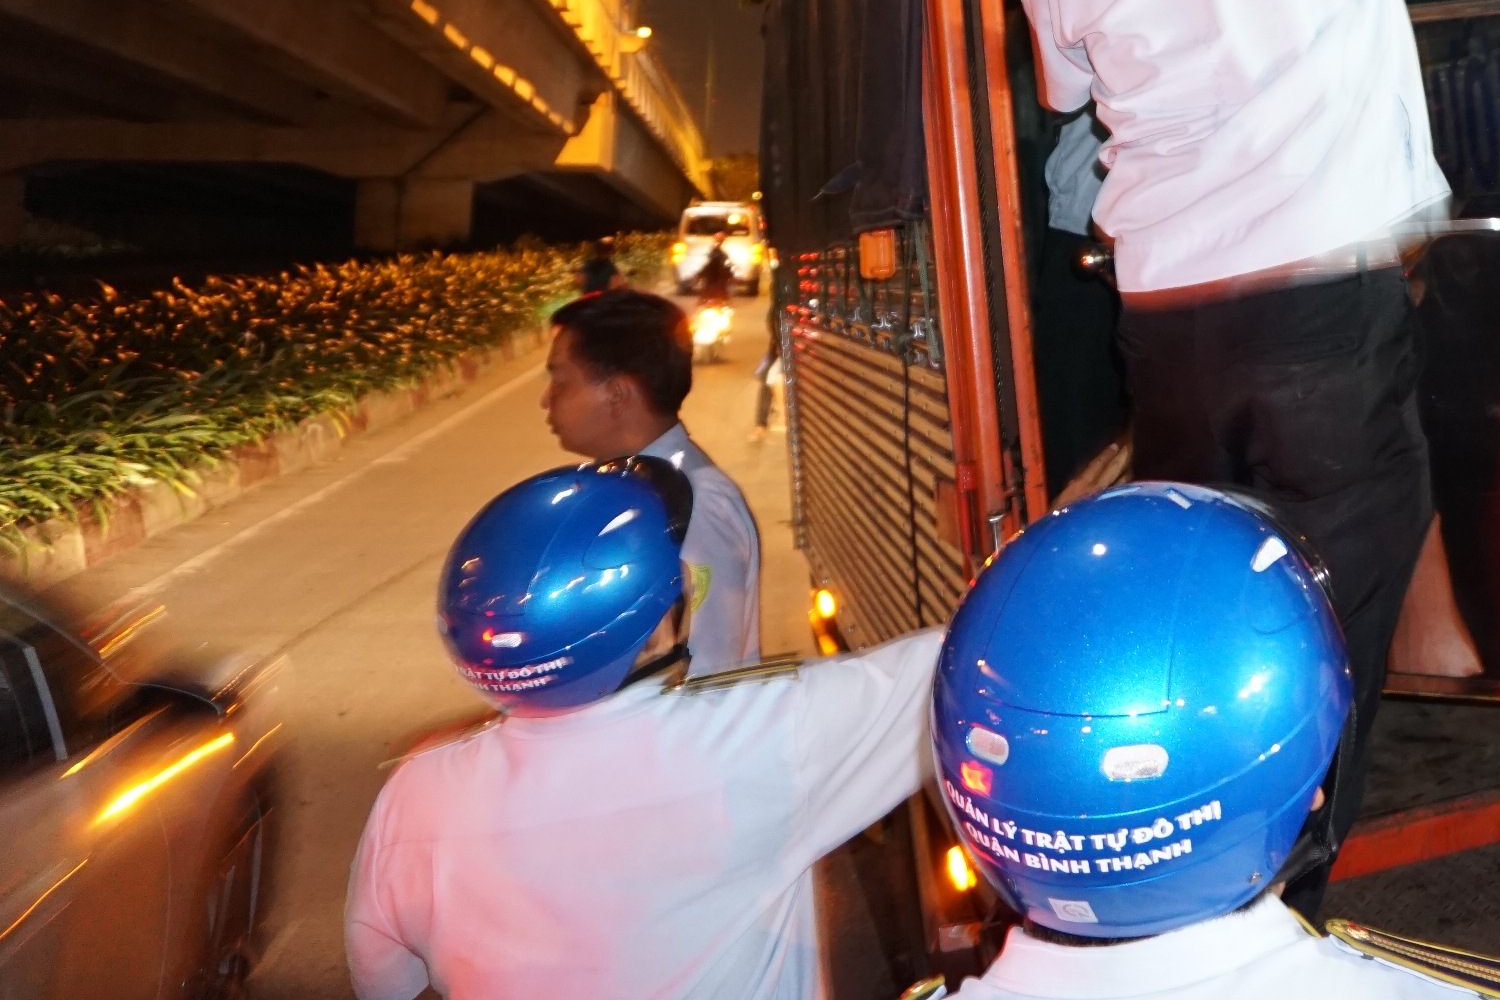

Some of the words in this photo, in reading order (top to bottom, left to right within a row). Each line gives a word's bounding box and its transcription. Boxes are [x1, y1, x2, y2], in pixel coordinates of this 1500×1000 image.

[946, 780, 990, 829] QUẢN
[993, 817, 1018, 840] LÝ
[1020, 829, 1086, 855] TRẬT
[1089, 828, 1129, 852] TỰ
[1131, 817, 1175, 844] ĐÔ
[1174, 800, 1222, 831] THỊ
[964, 822, 1021, 864] QUẬN
[1023, 852, 1092, 875] BÌNH
[1095, 838, 1193, 874] THẠNH
